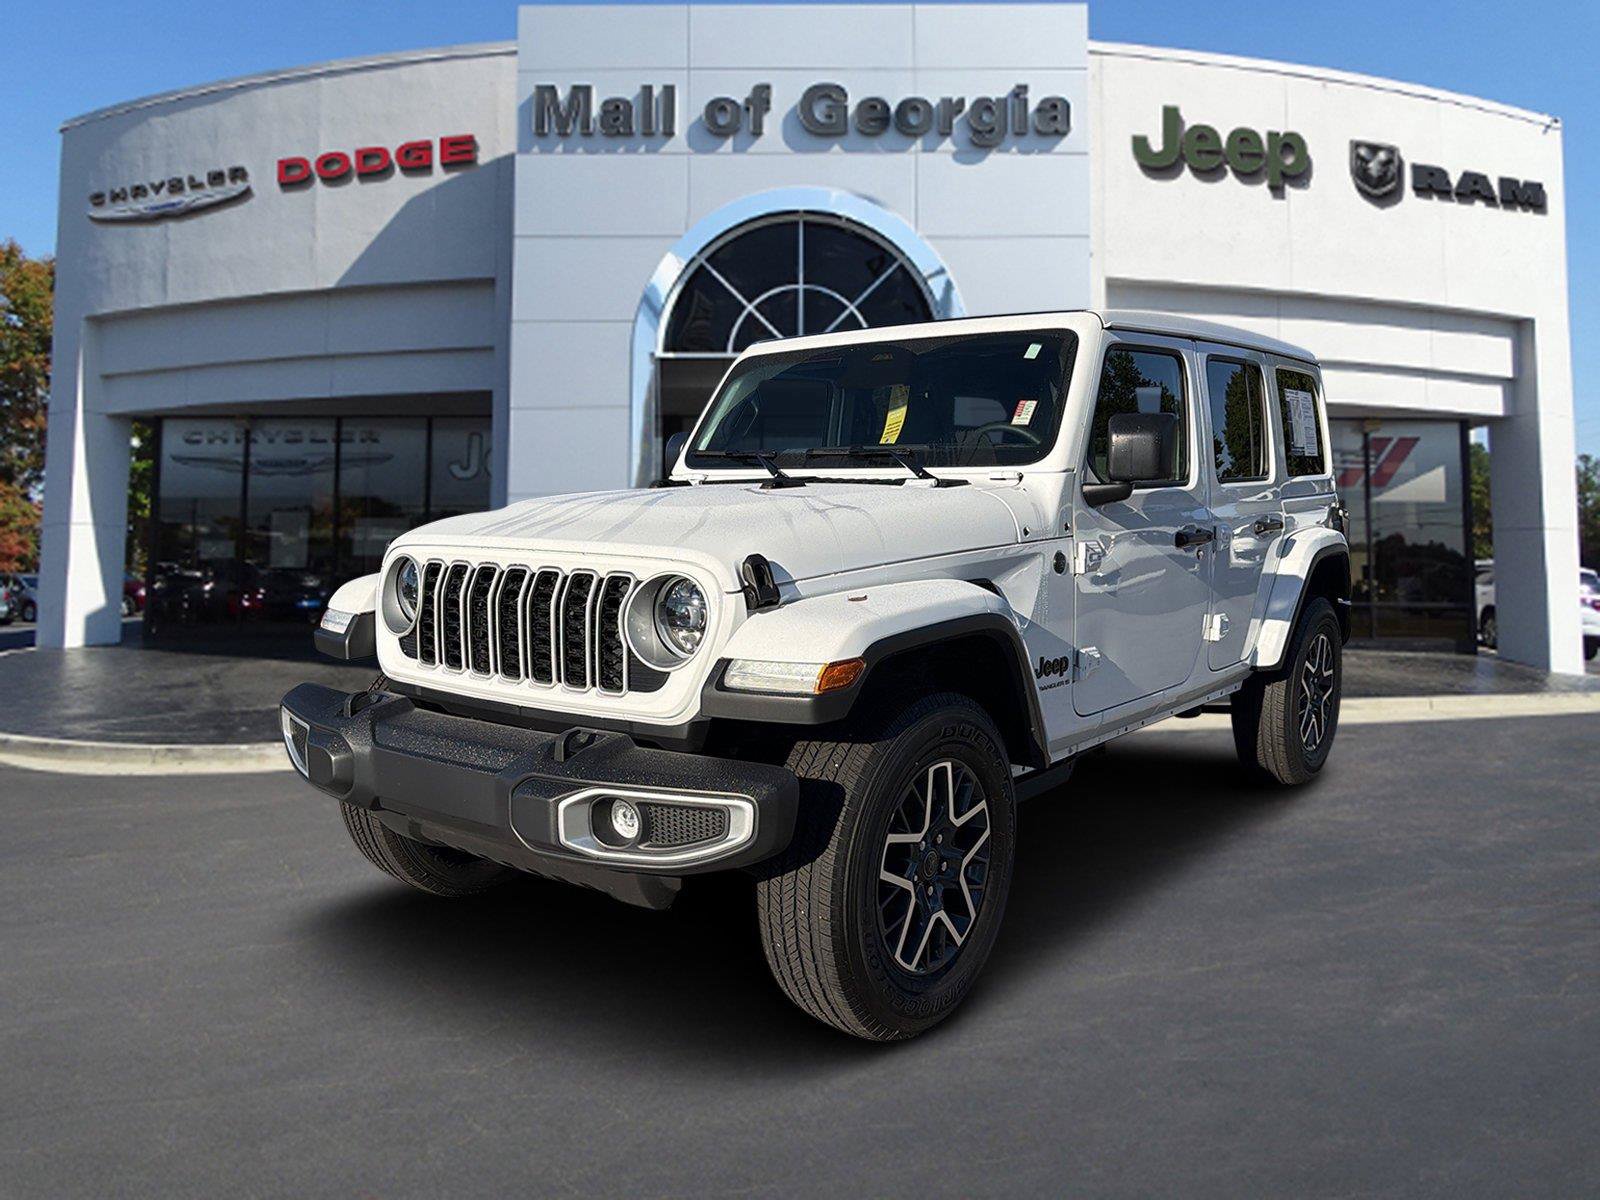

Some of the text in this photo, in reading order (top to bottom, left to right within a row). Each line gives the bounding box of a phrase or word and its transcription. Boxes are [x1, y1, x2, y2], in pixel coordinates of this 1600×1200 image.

[532, 82, 1073, 149] Mall of Georgia
[275, 134, 477, 188] DODGE
[1131, 104, 1310, 193] Jeep
[89, 166, 249, 207] CHRYSLER
[1411, 163, 1548, 212] RAM
[183, 429, 380, 445] CHRYSLER
[448, 432, 491, 481] J
[1034, 655, 1069, 679] Jeep
